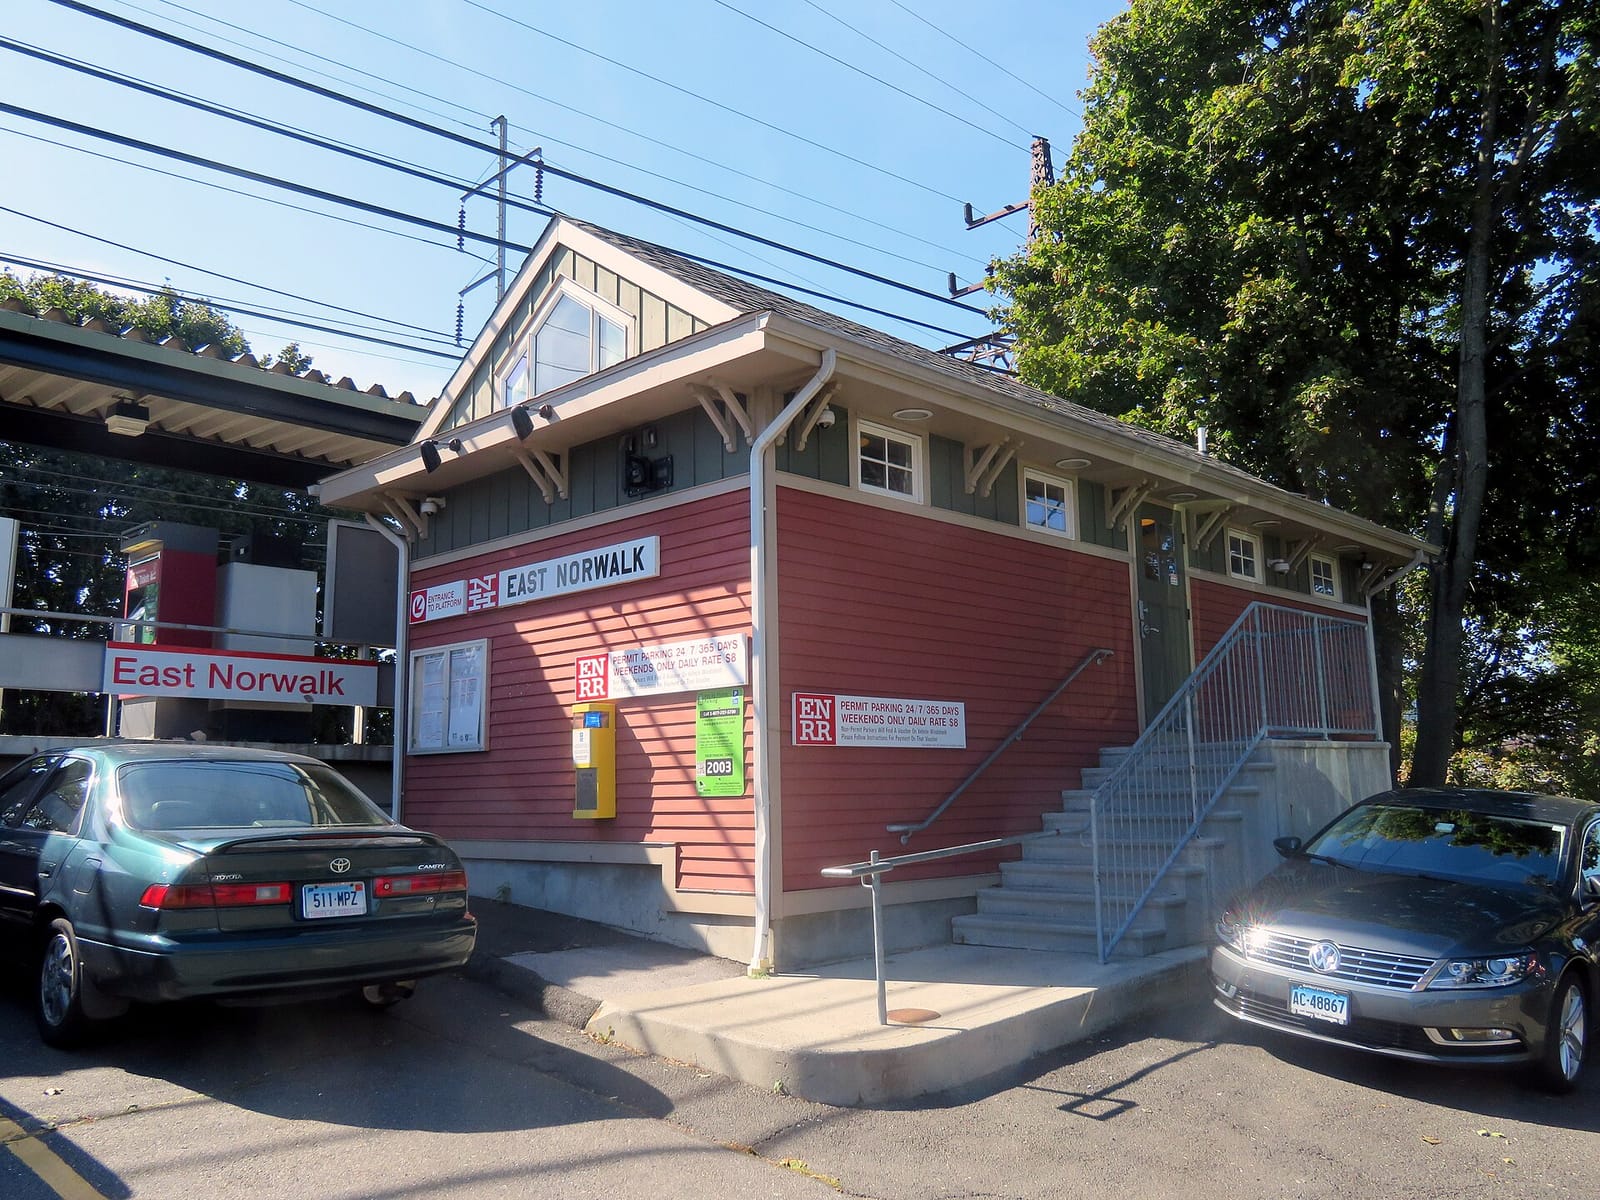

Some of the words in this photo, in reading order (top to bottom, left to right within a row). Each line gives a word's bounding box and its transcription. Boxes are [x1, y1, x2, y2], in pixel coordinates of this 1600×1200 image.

[507, 568, 547, 598] EAST
[556, 545, 644, 587] NORWALK
[427, 590, 455, 604] ENTRANCE
[427, 604, 435, 612] TO
[435, 598, 462, 611] PLATFORM
[612, 652, 639, 665] PERMIT
[641, 648, 673, 662] PARKING
[717, 639, 739, 652] DAYS
[112, 656, 196, 688] East
[207, 662, 345, 696] Norwalk
[578, 656, 607, 679] EN
[613, 663, 654, 676] WEEKENDS
[656, 660, 675, 672] ONLY
[678, 657, 699, 669] DAILY
[701, 654, 722, 666] RATE
[578, 677, 607, 698] RR
[799, 697, 833, 720] EN
[840, 700, 869, 712] PERMIT
[871, 702, 903, 713] PARKING
[942, 706, 960, 716] DAYS
[799, 719, 833, 742] RR
[841, 713, 885, 725] WEEKENDS
[887, 715, 906, 725] ONLY
[908, 716, 927, 727] DAILY
[929, 717, 947, 727] RATE
[706, 761, 731, 774] 2003
